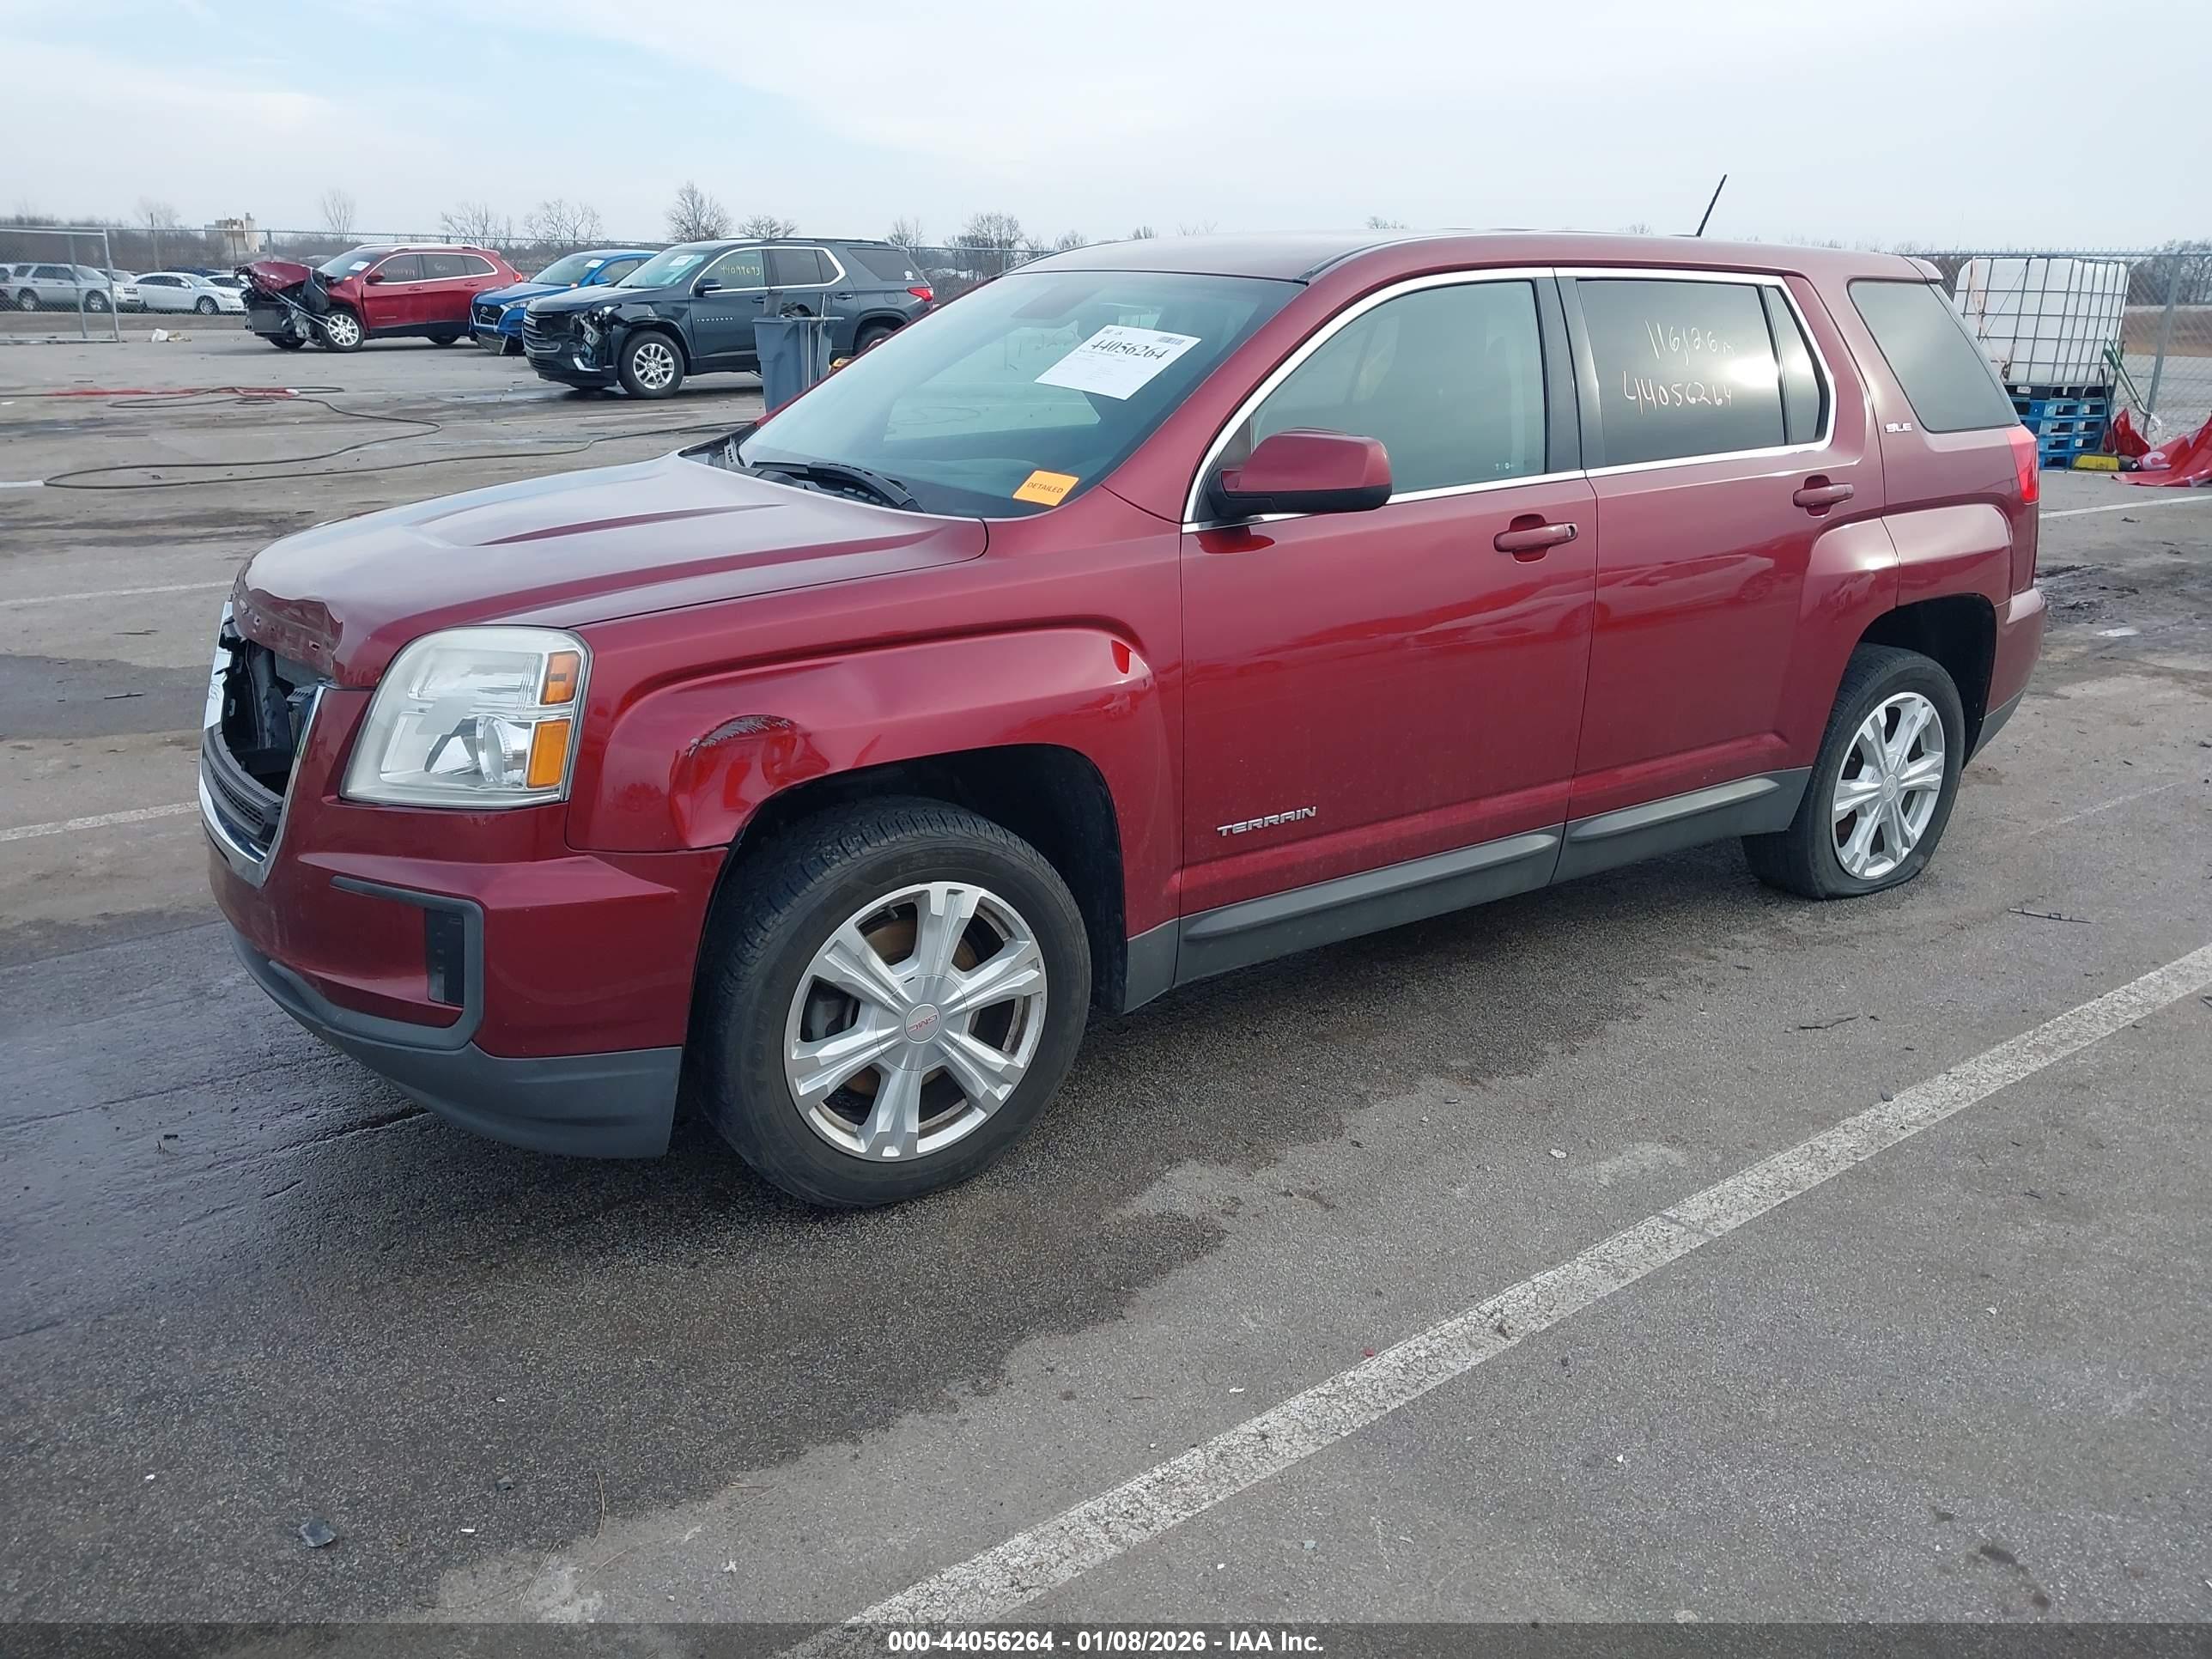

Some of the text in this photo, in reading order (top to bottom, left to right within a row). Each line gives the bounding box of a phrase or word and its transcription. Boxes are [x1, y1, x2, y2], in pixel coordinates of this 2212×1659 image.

[1091, 338, 1170, 361] 44056264
[1622, 370, 1731, 416] 44056264
[1884, 422, 1912, 433] SLE
[1026, 482, 1064, 494] DETAILED
[1216, 805, 1316, 837] TERRAIN
